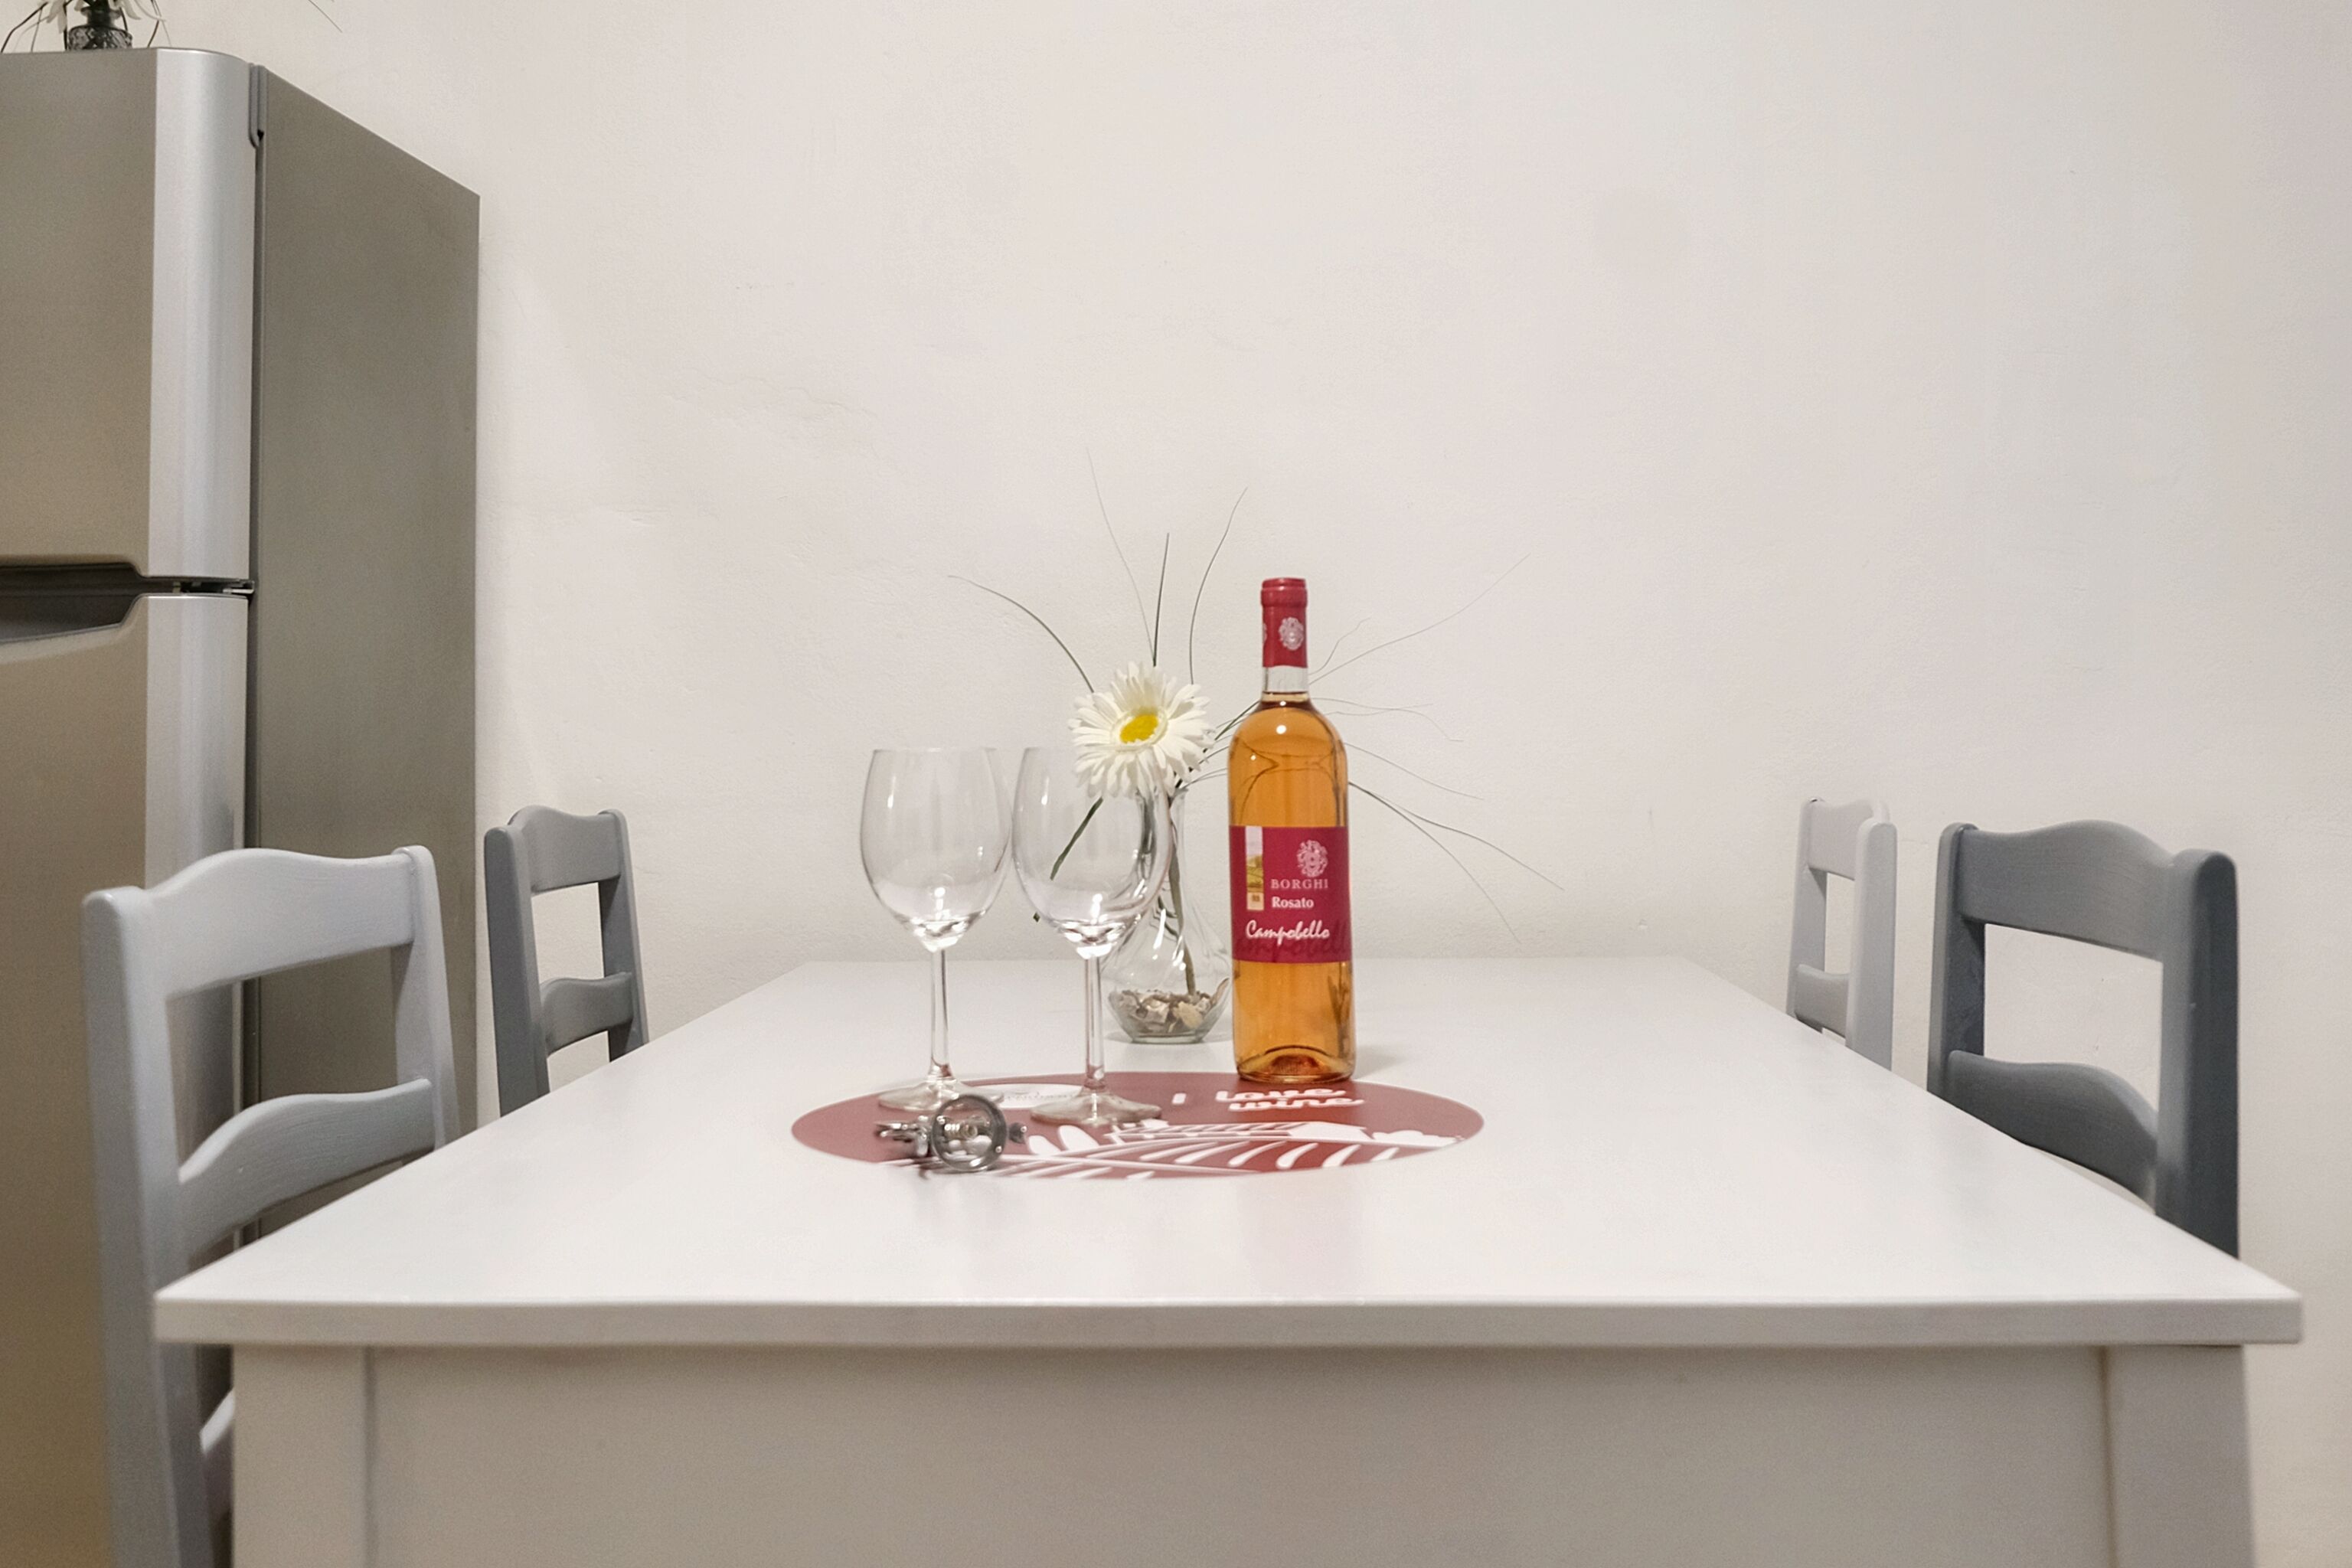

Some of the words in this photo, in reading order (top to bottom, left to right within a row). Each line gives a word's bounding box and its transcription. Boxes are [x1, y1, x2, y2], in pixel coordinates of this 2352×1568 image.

[1271, 879, 1328, 889] BORGHI
[1272, 897, 1314, 909] Rosato
[1246, 920, 1330, 946] Campobello
[1230, 1097, 1364, 1111] wine
